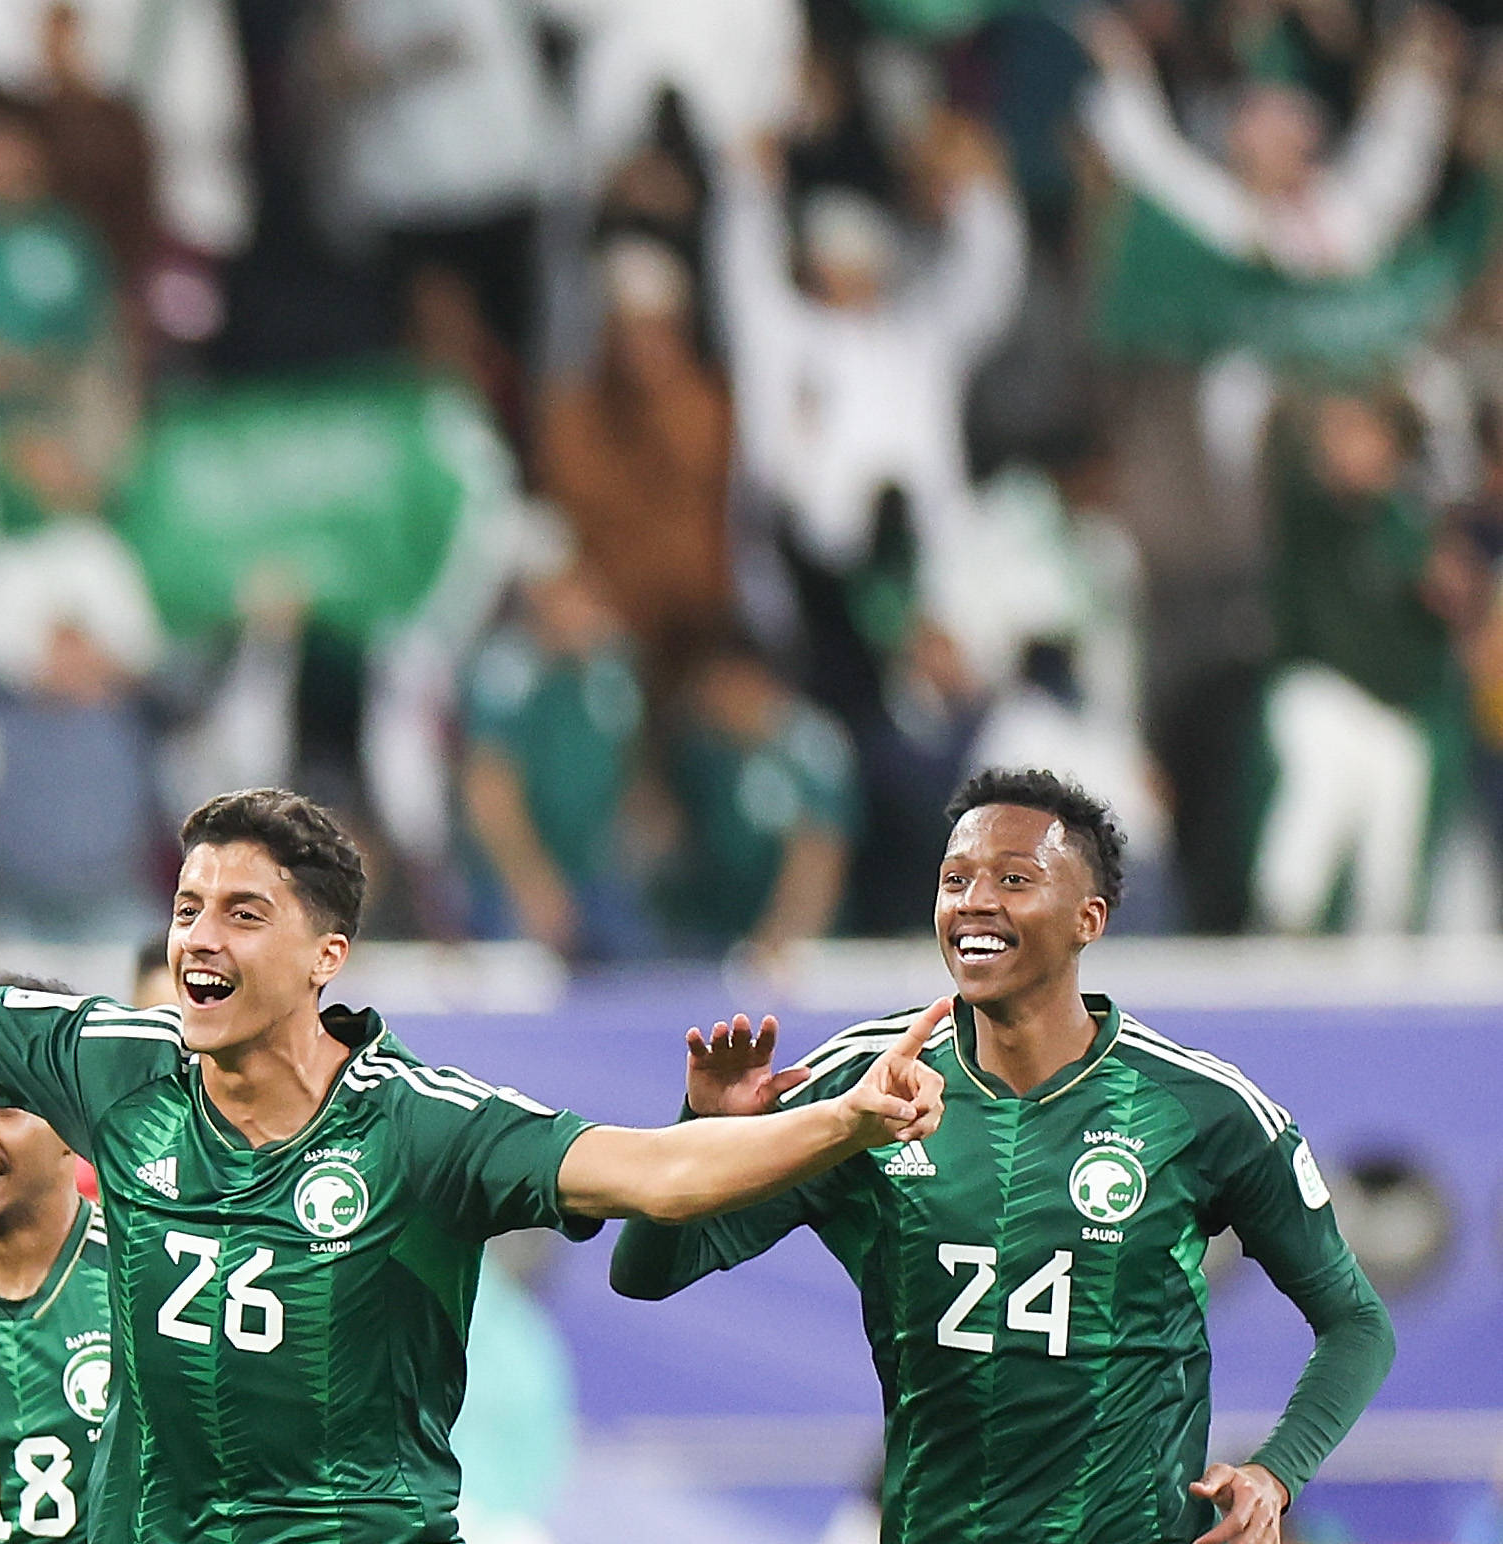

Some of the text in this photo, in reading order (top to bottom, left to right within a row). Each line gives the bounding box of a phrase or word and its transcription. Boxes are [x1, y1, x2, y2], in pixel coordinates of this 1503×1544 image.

[883, 1161, 937, 1177] adidas
[1107, 1191, 1131, 1203] SAFF
[332, 1206, 356, 1217] SAFF
[1081, 1226, 1125, 1244] SAUDI
[309, 1241, 352, 1253] SAUDI
[157, 1230, 285, 1354] 26
[937, 1242, 1074, 1357] 24
